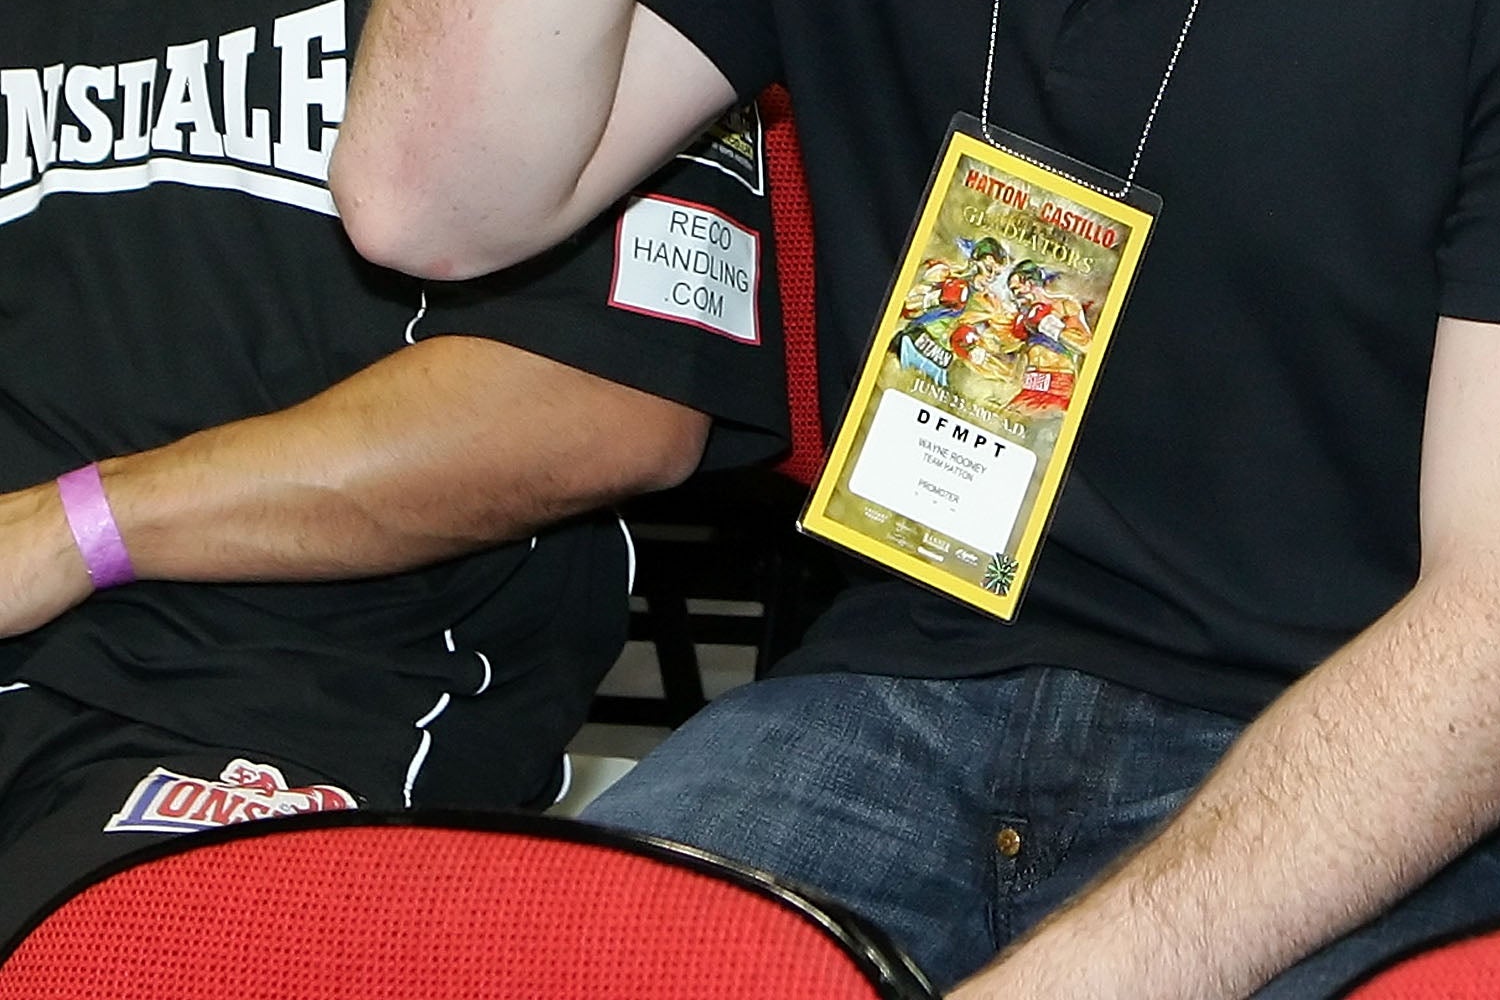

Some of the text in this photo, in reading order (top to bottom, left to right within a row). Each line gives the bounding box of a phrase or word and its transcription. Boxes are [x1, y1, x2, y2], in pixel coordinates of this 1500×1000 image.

[964, 168, 1118, 250] HATTON CASTILLO
[669, 210, 732, 251] RECO
[633, 236, 749, 293] HANDLING
[911, 377, 949, 404] JUNE
[919, 438, 987, 474] WAYNE ROONEY
